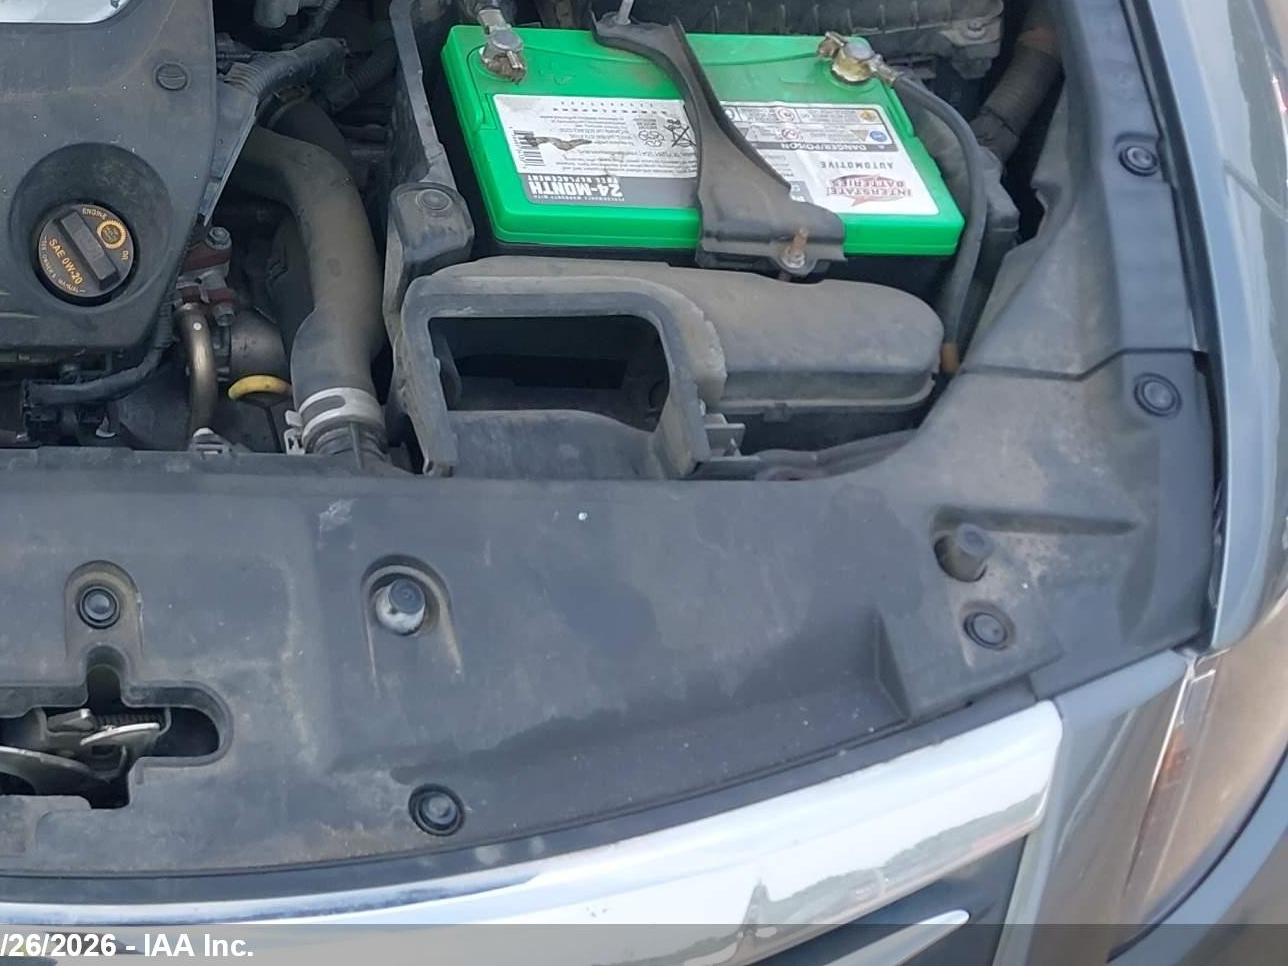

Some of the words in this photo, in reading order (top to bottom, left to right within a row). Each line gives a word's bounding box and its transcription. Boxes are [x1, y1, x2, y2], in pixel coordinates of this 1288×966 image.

[819, 160, 894, 170] AUTOMOTIVE
[528, 180, 624, 197] 24-MONTH
[830, 178, 905, 189] BATTERIES
[826, 186, 912, 197] INTERSTATE
[81, 207, 108, 220] ENGINE
[49, 237, 66, 259] SAE
[61, 256, 84, 285] 0W-20
